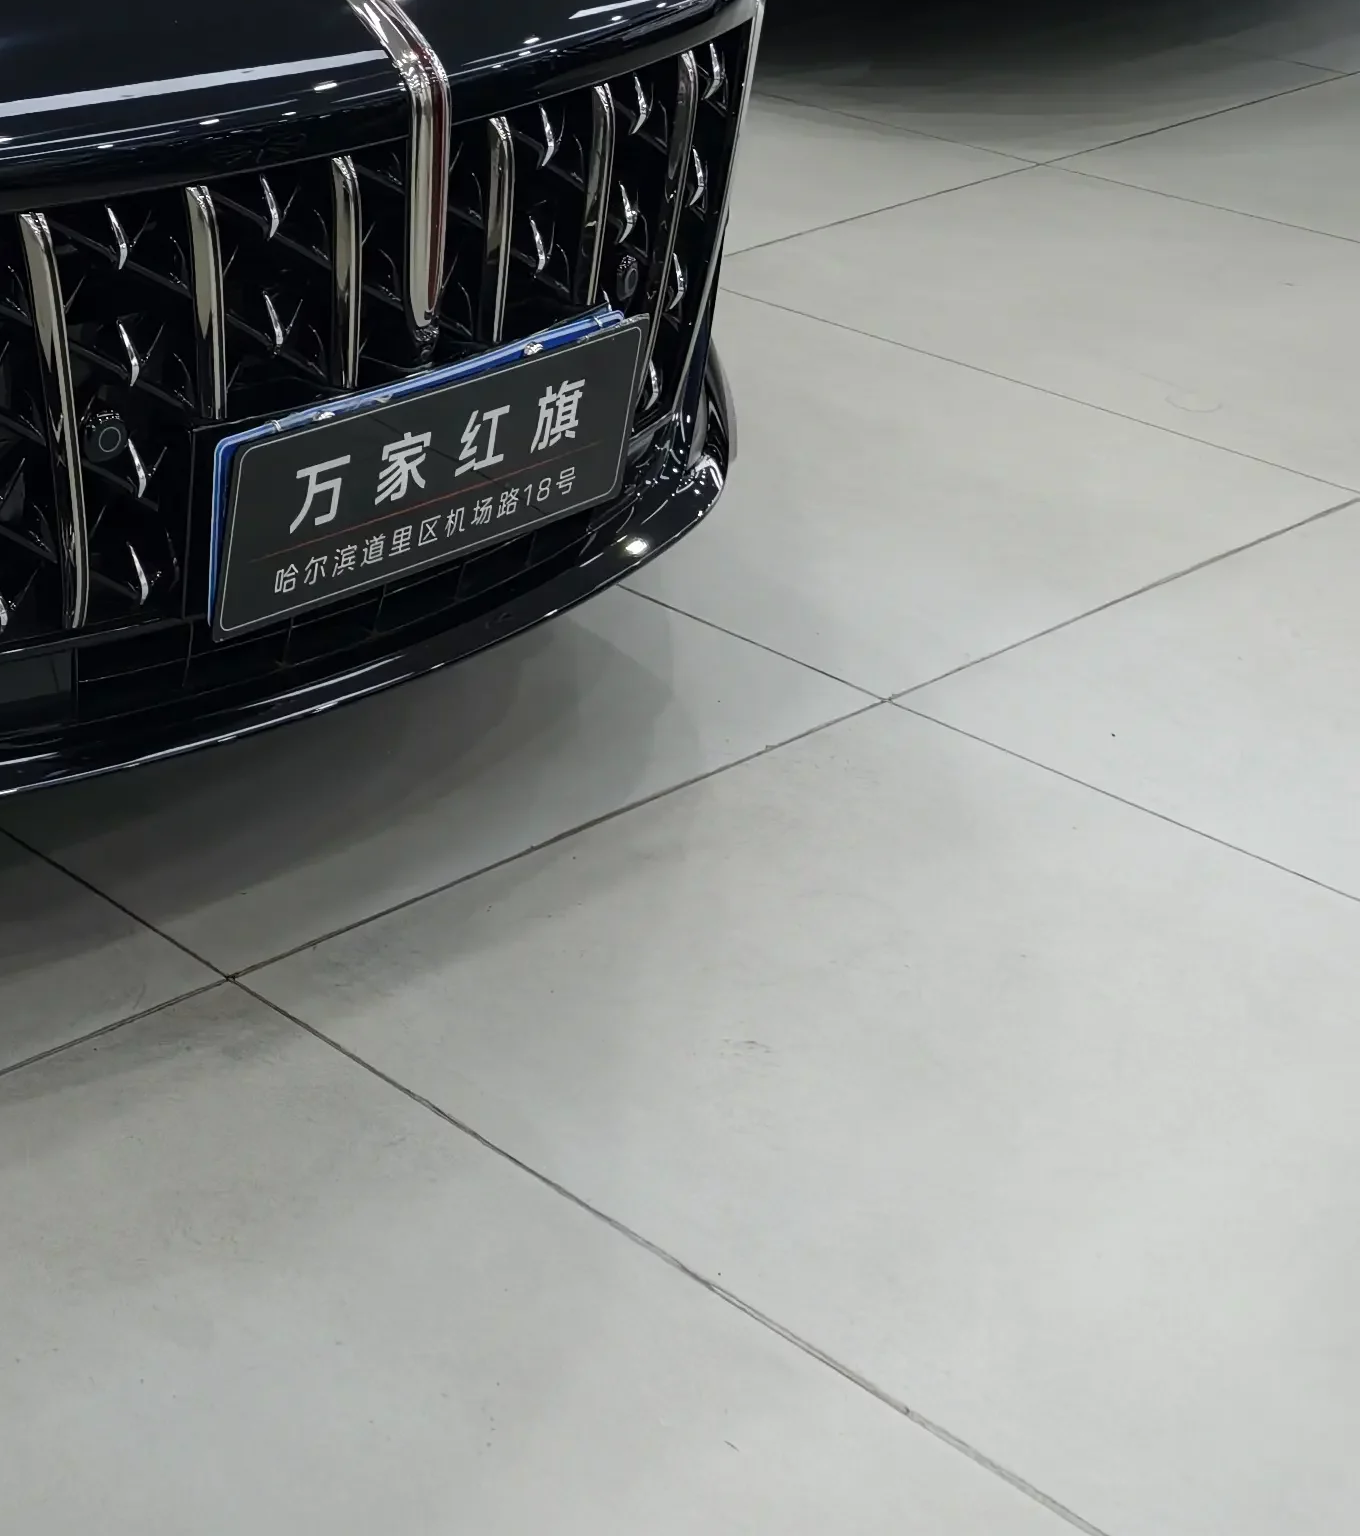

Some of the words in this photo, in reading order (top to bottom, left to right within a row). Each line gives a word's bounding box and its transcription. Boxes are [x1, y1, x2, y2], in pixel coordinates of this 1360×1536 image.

[288, 378, 586, 534] 万家红旗
[273, 466, 577, 595] 哈尔滨道里区机场路18号
